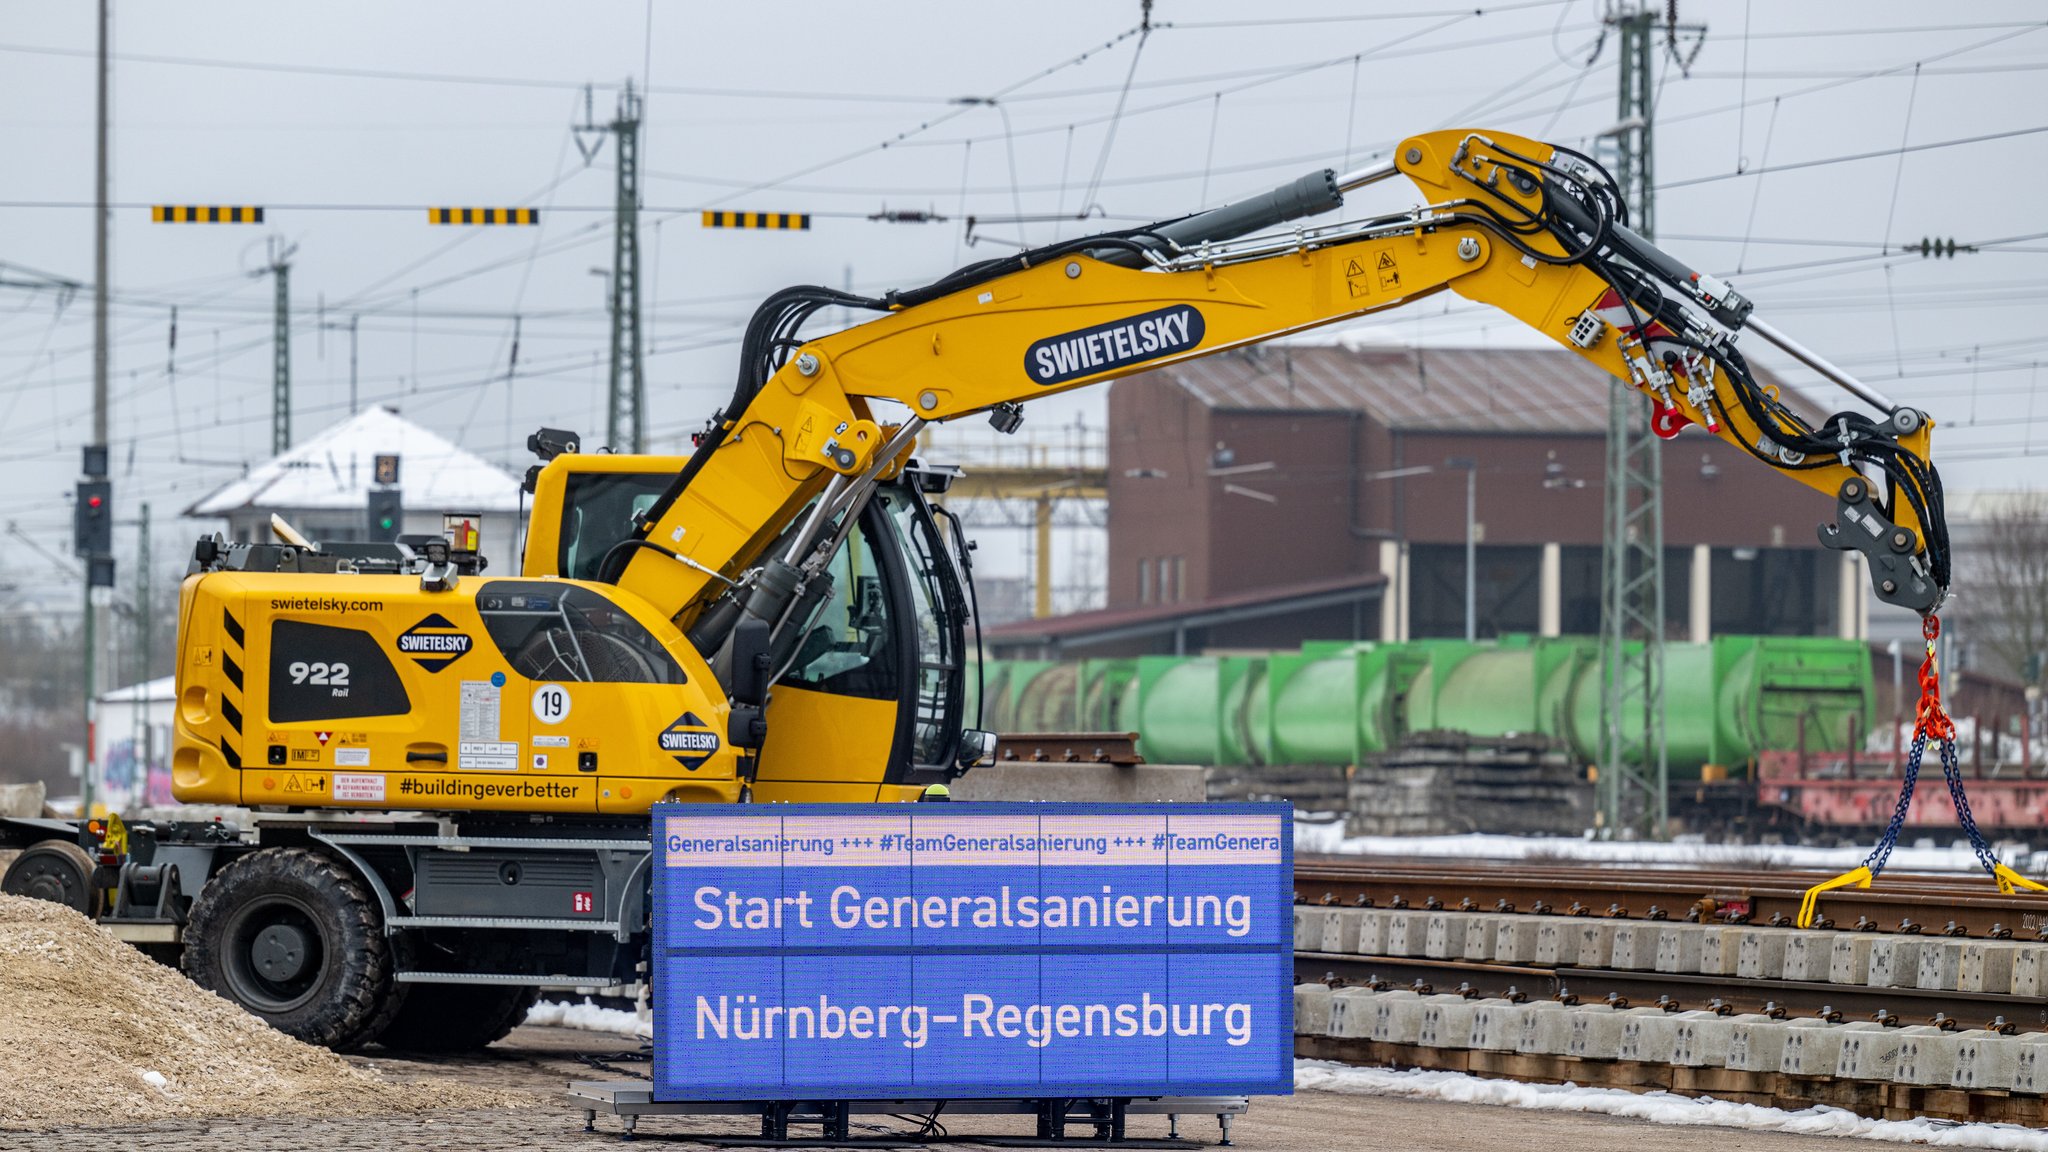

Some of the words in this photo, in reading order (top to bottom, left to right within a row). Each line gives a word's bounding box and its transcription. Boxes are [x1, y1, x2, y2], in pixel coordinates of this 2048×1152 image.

[1035, 310, 1189, 379] SWIETELSKY
[271, 597, 383, 614] swietelsky.com
[401, 635, 468, 651] SWIETELSKY
[289, 661, 350, 685] 922
[331, 687, 349, 697] Rail
[541, 691, 562, 716] 19
[662, 733, 717, 749] SWIETELSKY
[400, 778, 579, 800] #buildingeverbetter
[668, 834, 834, 856] Generalsanierung
[840, 837, 873, 848] +++
[879, 833, 1107, 855] #TeamGeneralsanierung
[1113, 836, 1146, 847] +++
[1152, 832, 1279, 851] #TeamGenera
[693, 886, 813, 930] Start
[829, 885, 1251, 937] Generalsanierung
